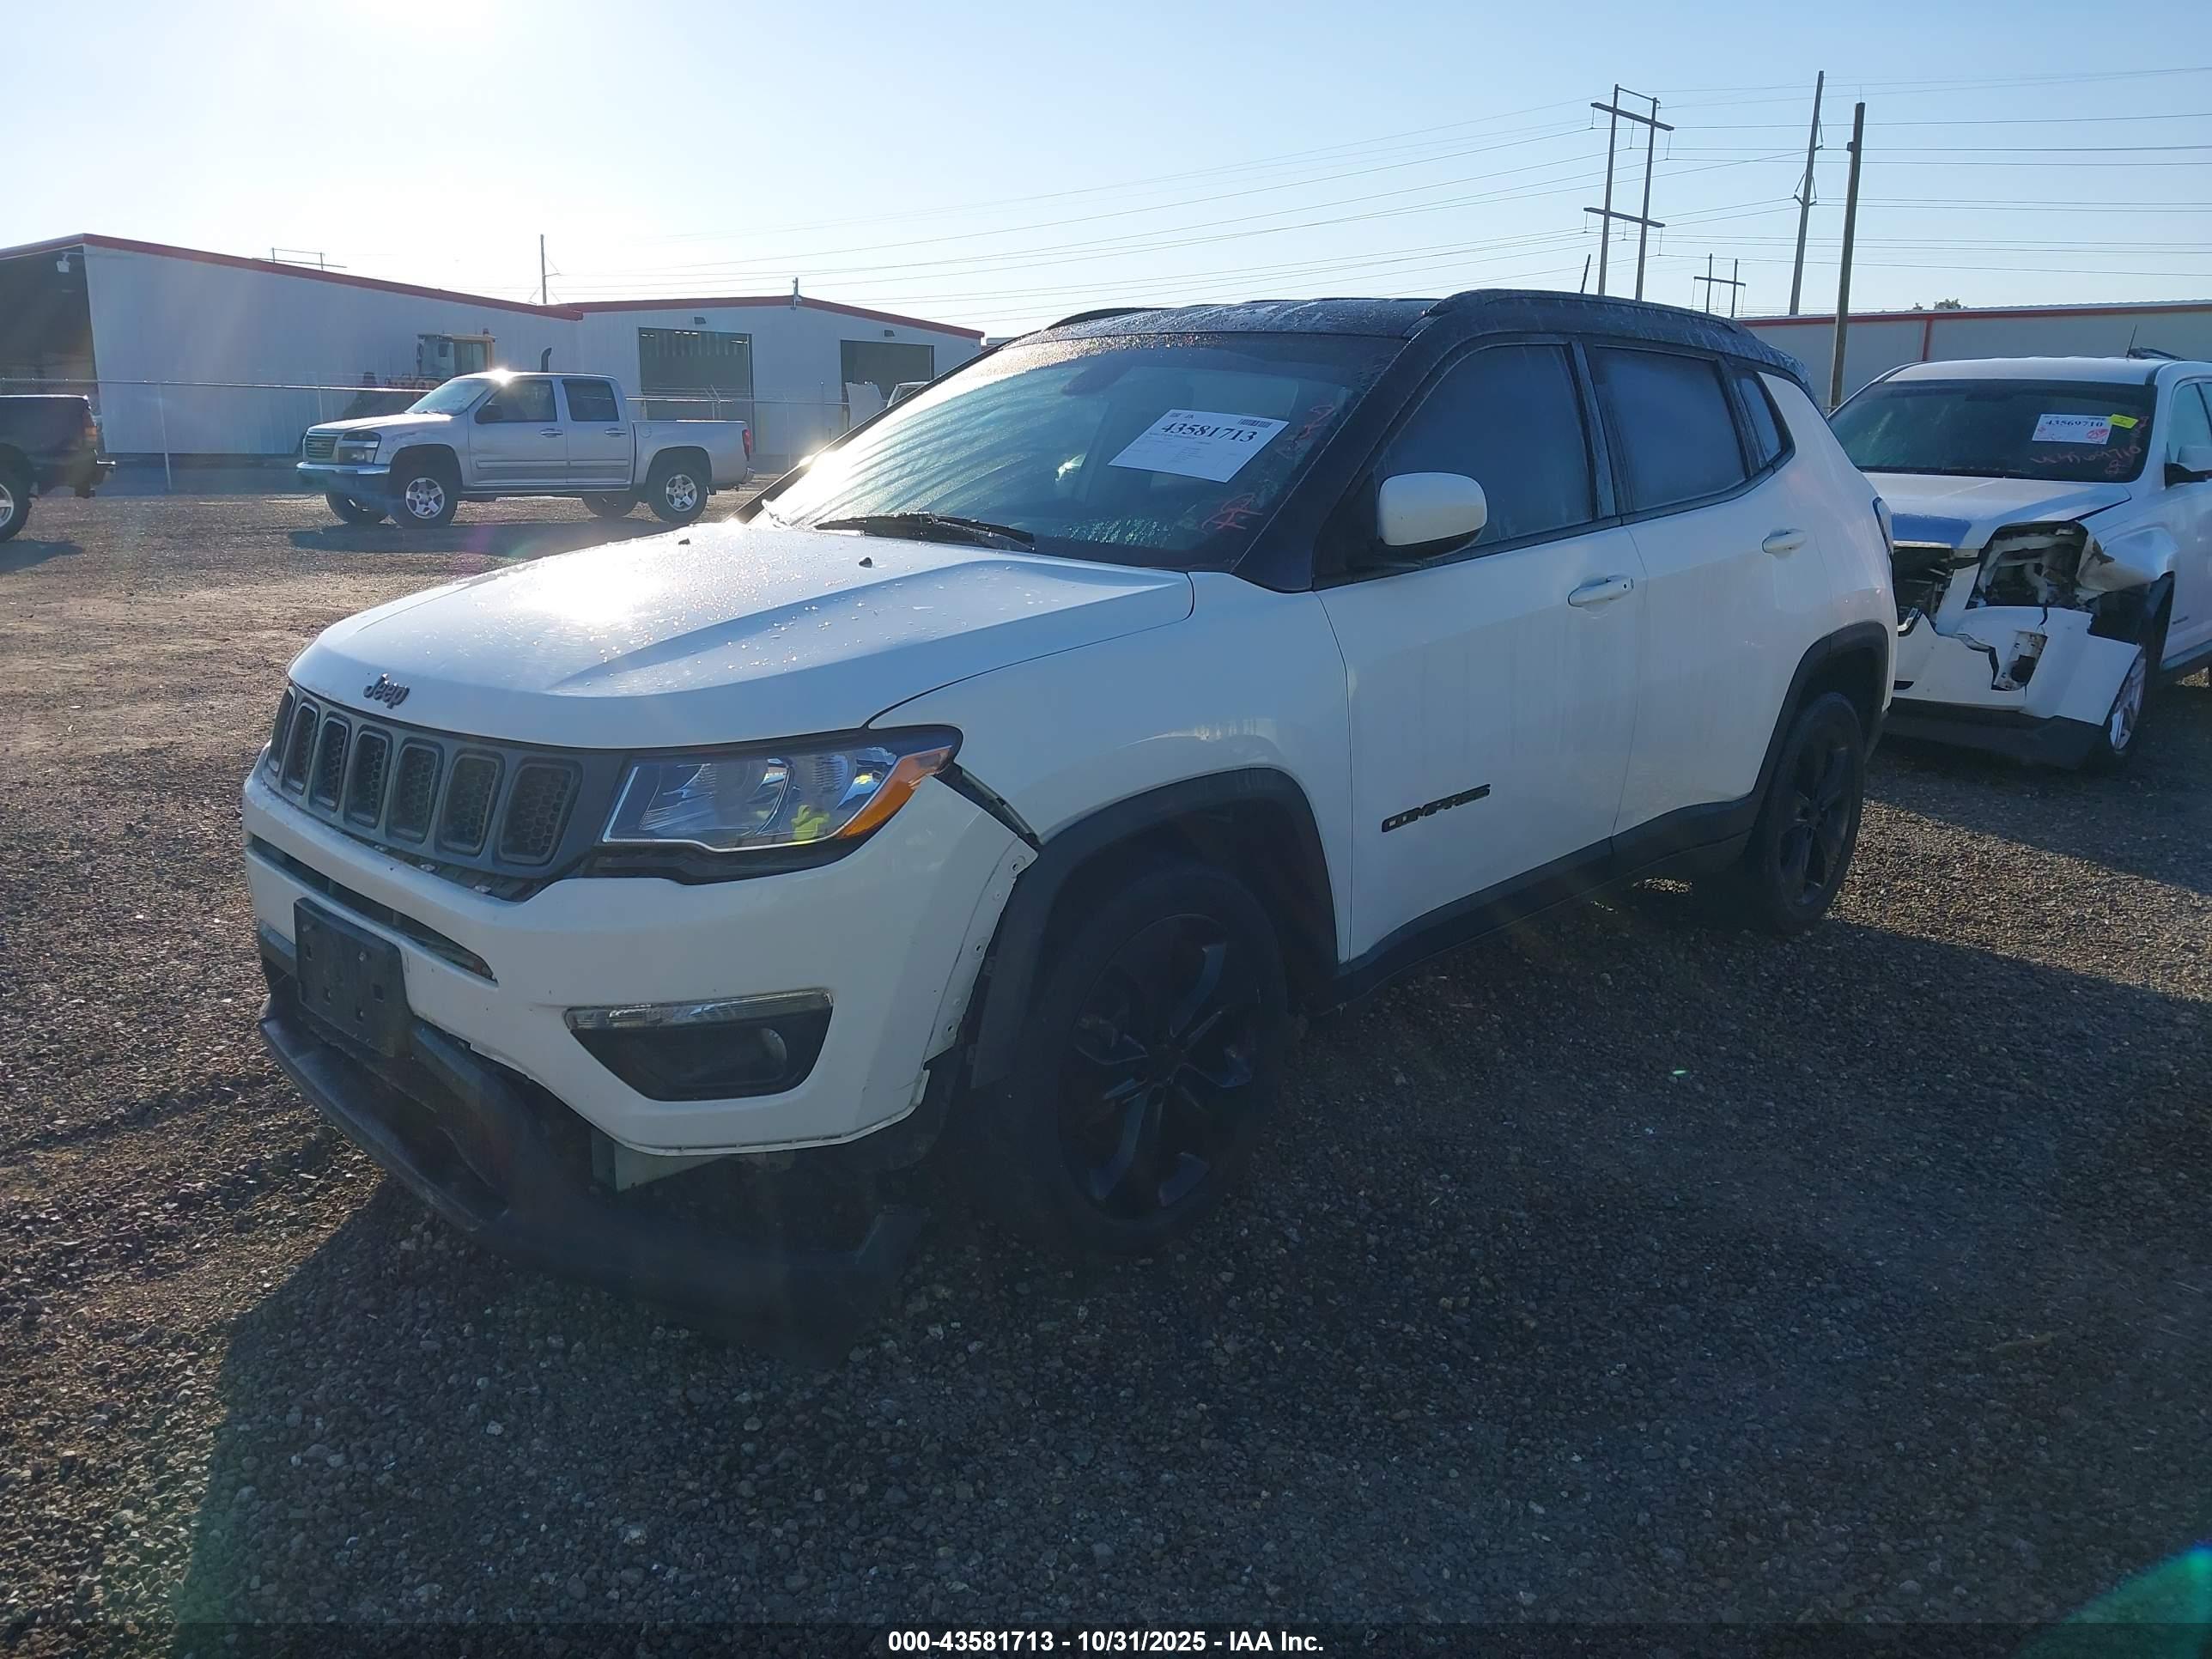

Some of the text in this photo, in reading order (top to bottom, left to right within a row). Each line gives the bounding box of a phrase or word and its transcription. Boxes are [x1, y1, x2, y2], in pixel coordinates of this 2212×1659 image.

[1160, 422, 1258, 443] 43581713
[2045, 419, 2104, 428] 43569710
[363, 673, 410, 709] Jeep
